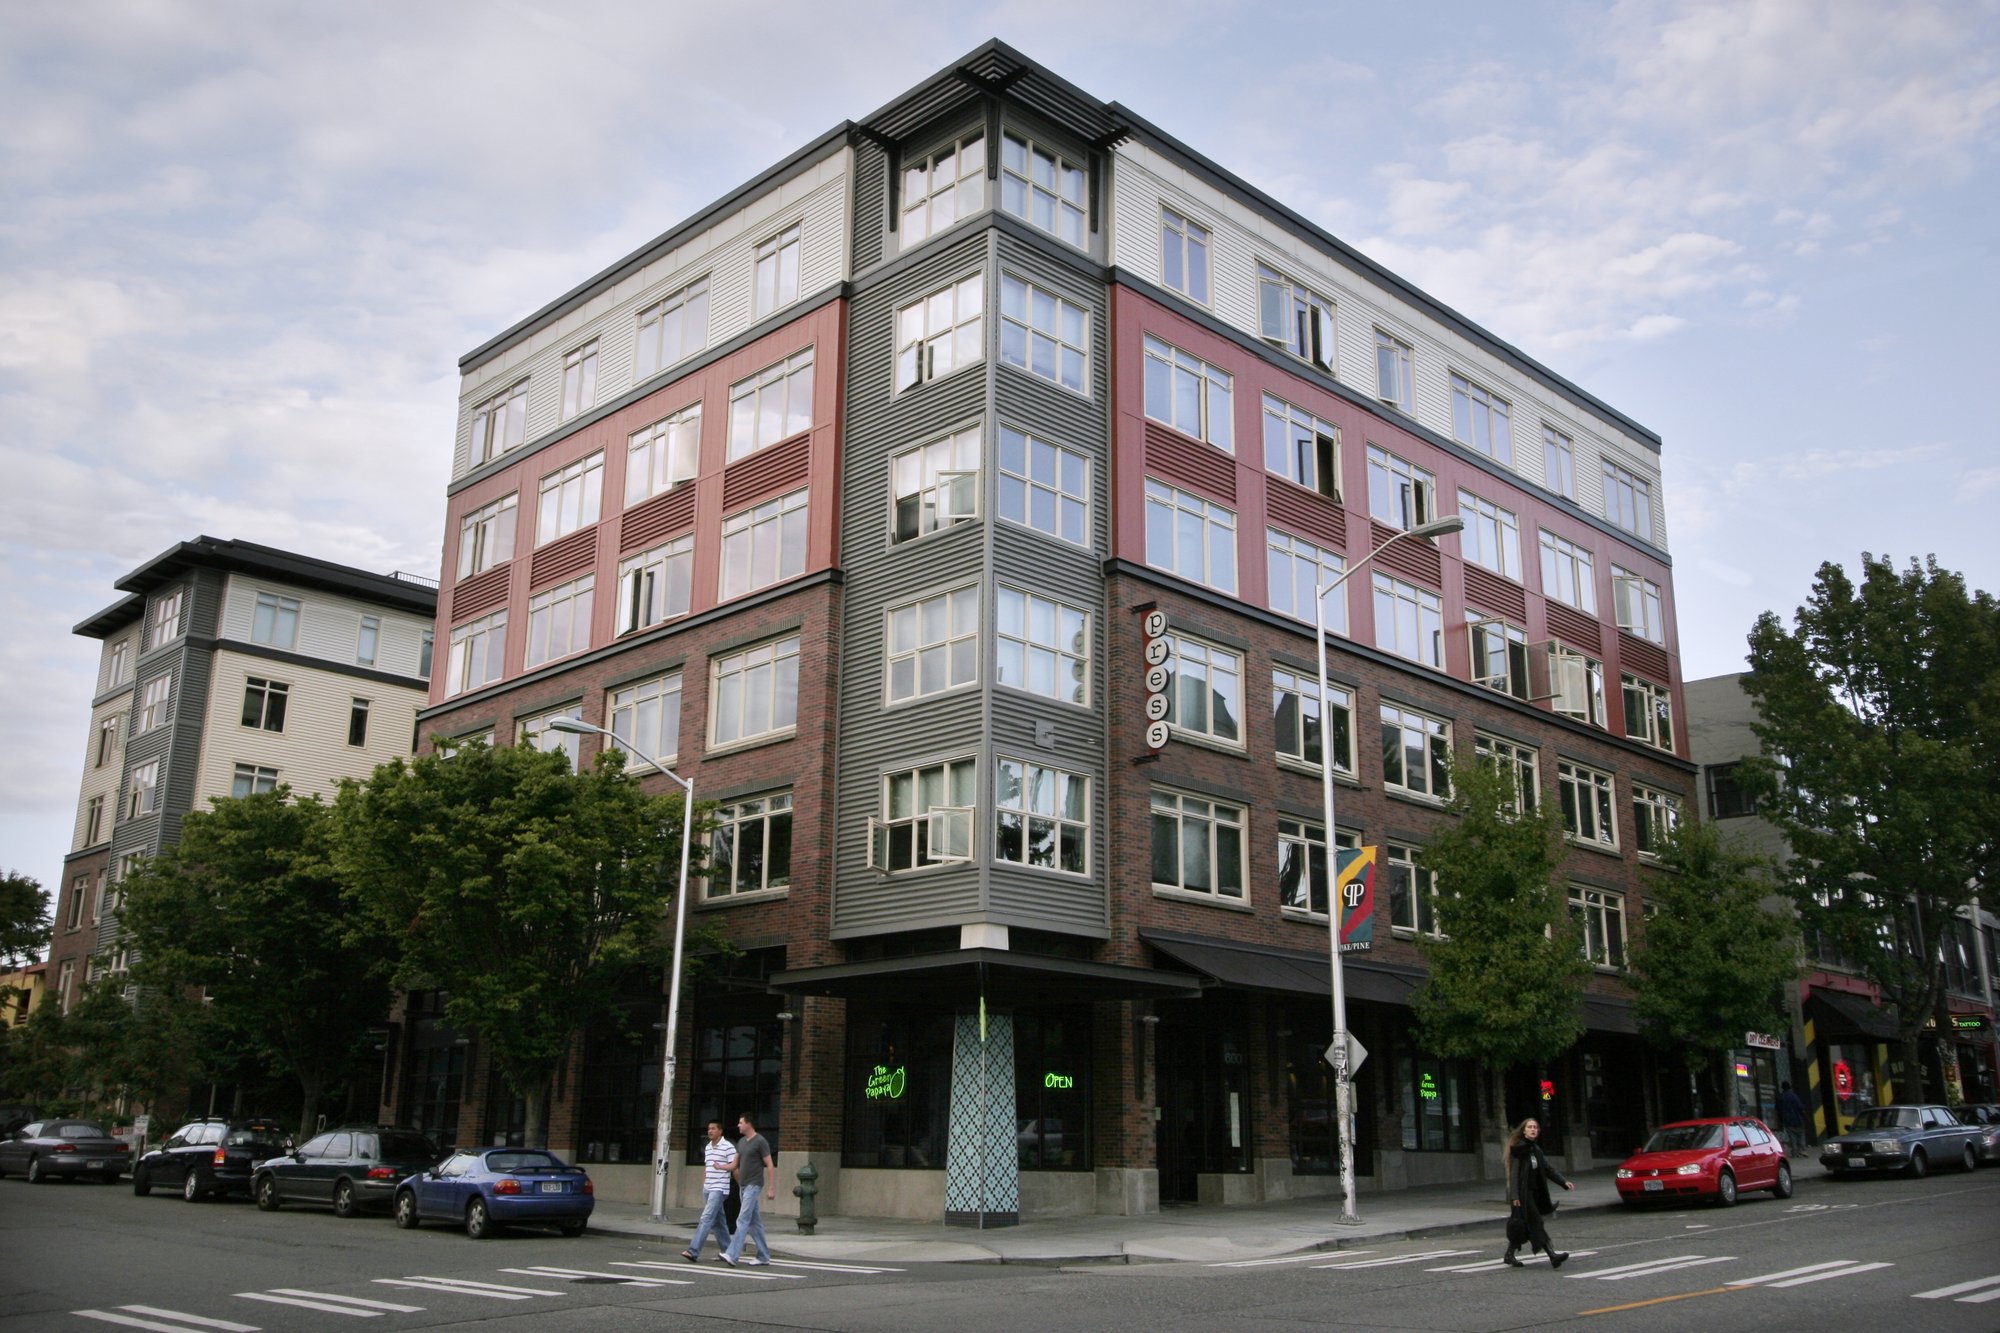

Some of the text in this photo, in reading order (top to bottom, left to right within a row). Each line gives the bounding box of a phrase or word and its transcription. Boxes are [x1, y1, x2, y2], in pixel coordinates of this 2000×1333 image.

[1150, 614, 1163, 743] press
[874, 1065, 887, 1076] The
[868, 1074, 892, 1087] Green
[1045, 1073, 1073, 1088] OPEN
[865, 1083, 891, 1100] Papaya
